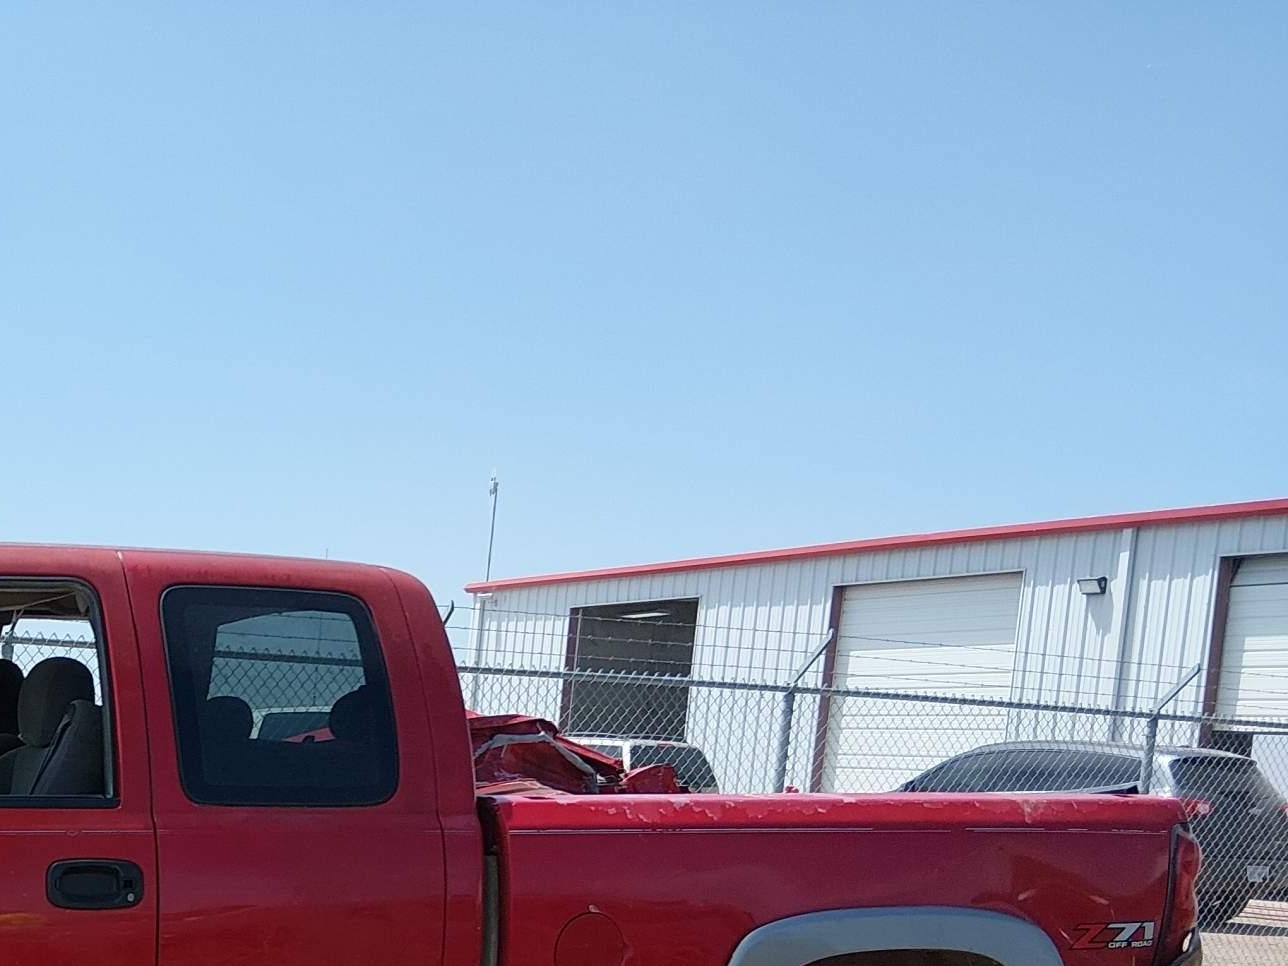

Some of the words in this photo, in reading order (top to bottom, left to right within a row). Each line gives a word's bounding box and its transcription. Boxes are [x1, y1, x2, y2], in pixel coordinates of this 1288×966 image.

[1071, 921, 1155, 949] Z71
[1108, 941, 1127, 949] OFF
[1131, 940, 1153, 948] ROAD
